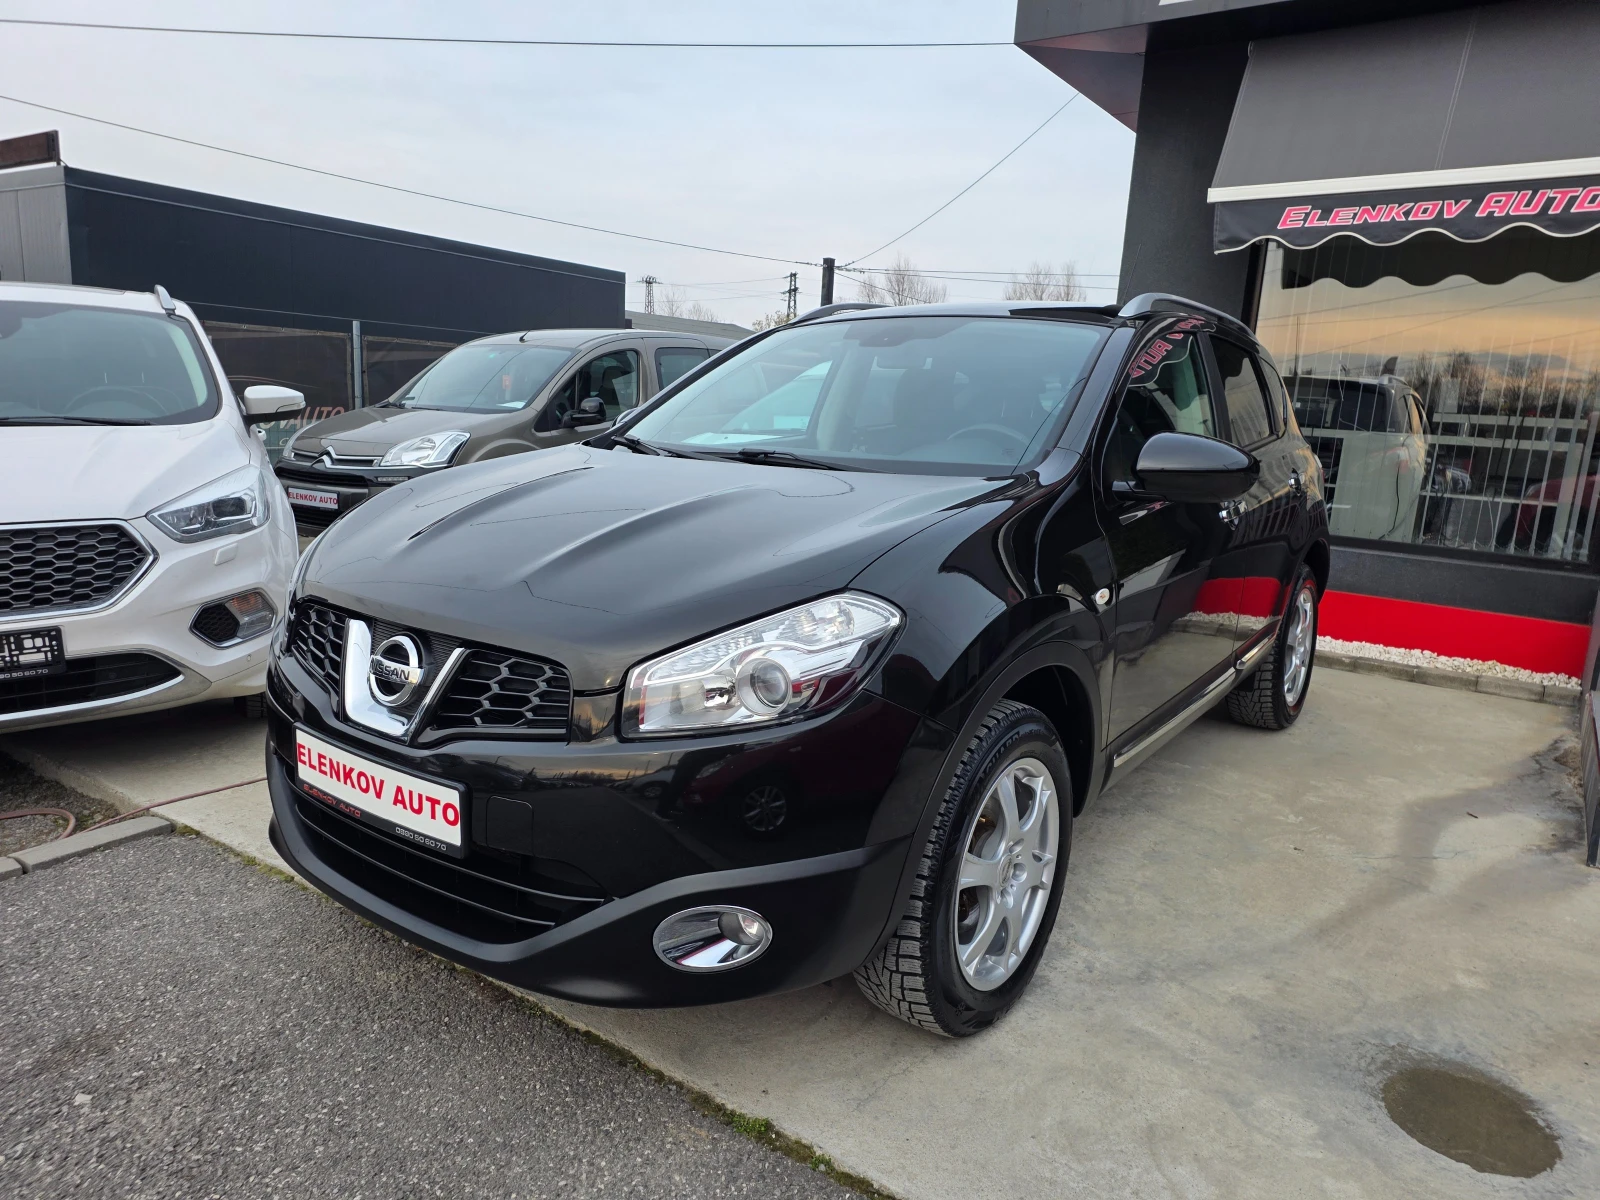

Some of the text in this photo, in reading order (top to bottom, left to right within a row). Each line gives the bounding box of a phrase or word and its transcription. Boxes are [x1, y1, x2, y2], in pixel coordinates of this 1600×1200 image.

[1475, 186, 1600, 217] AUTO
[288, 491, 338, 505] ELENKOV AUTO
[369, 656, 410, 681] NISSAN
[296, 742, 460, 827] ELENKOV AUTO
[339, 802, 361, 818] AUTO
